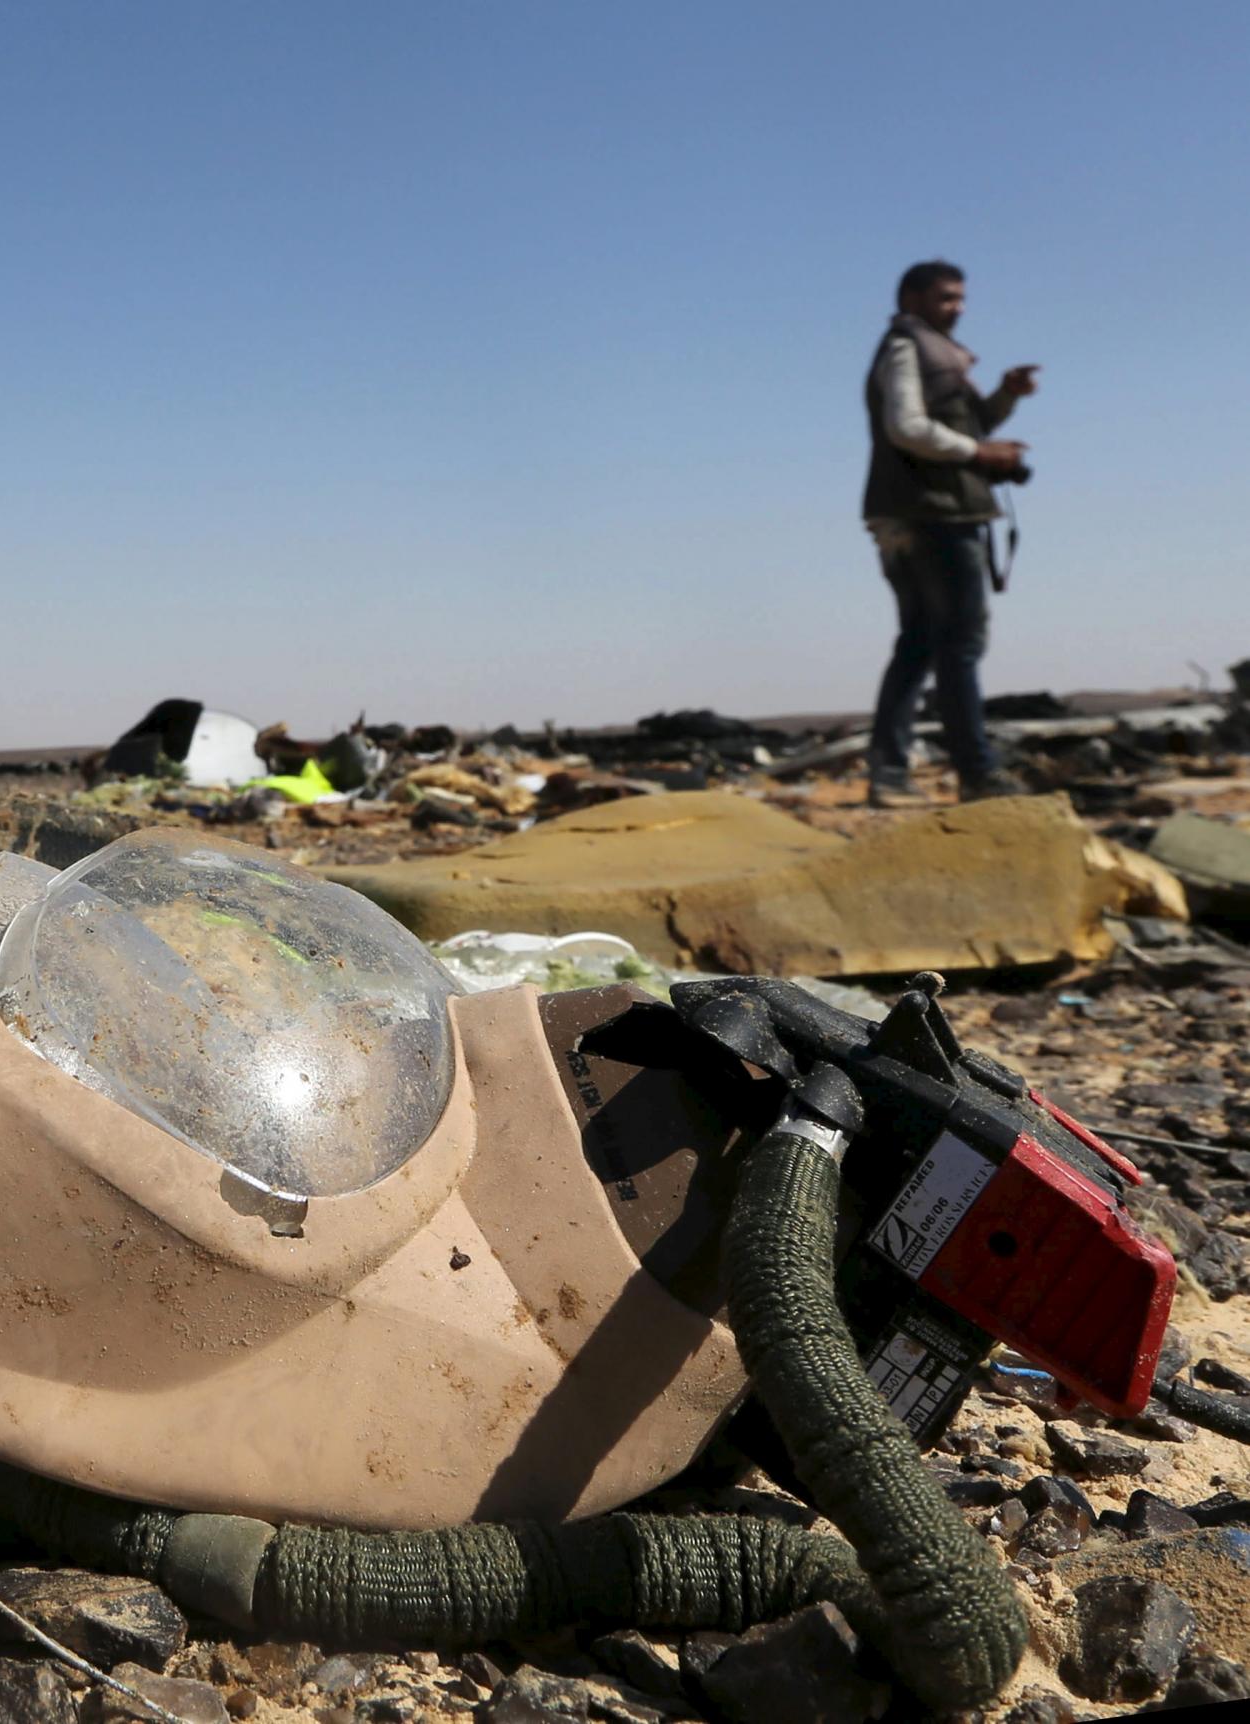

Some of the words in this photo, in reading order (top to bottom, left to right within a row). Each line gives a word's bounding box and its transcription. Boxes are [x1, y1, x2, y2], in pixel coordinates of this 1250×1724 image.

[893, 1159, 936, 1213] REPAIRED
[919, 1196, 950, 1233] 06/06
[900, 1237, 925, 1267] ZODIAC
